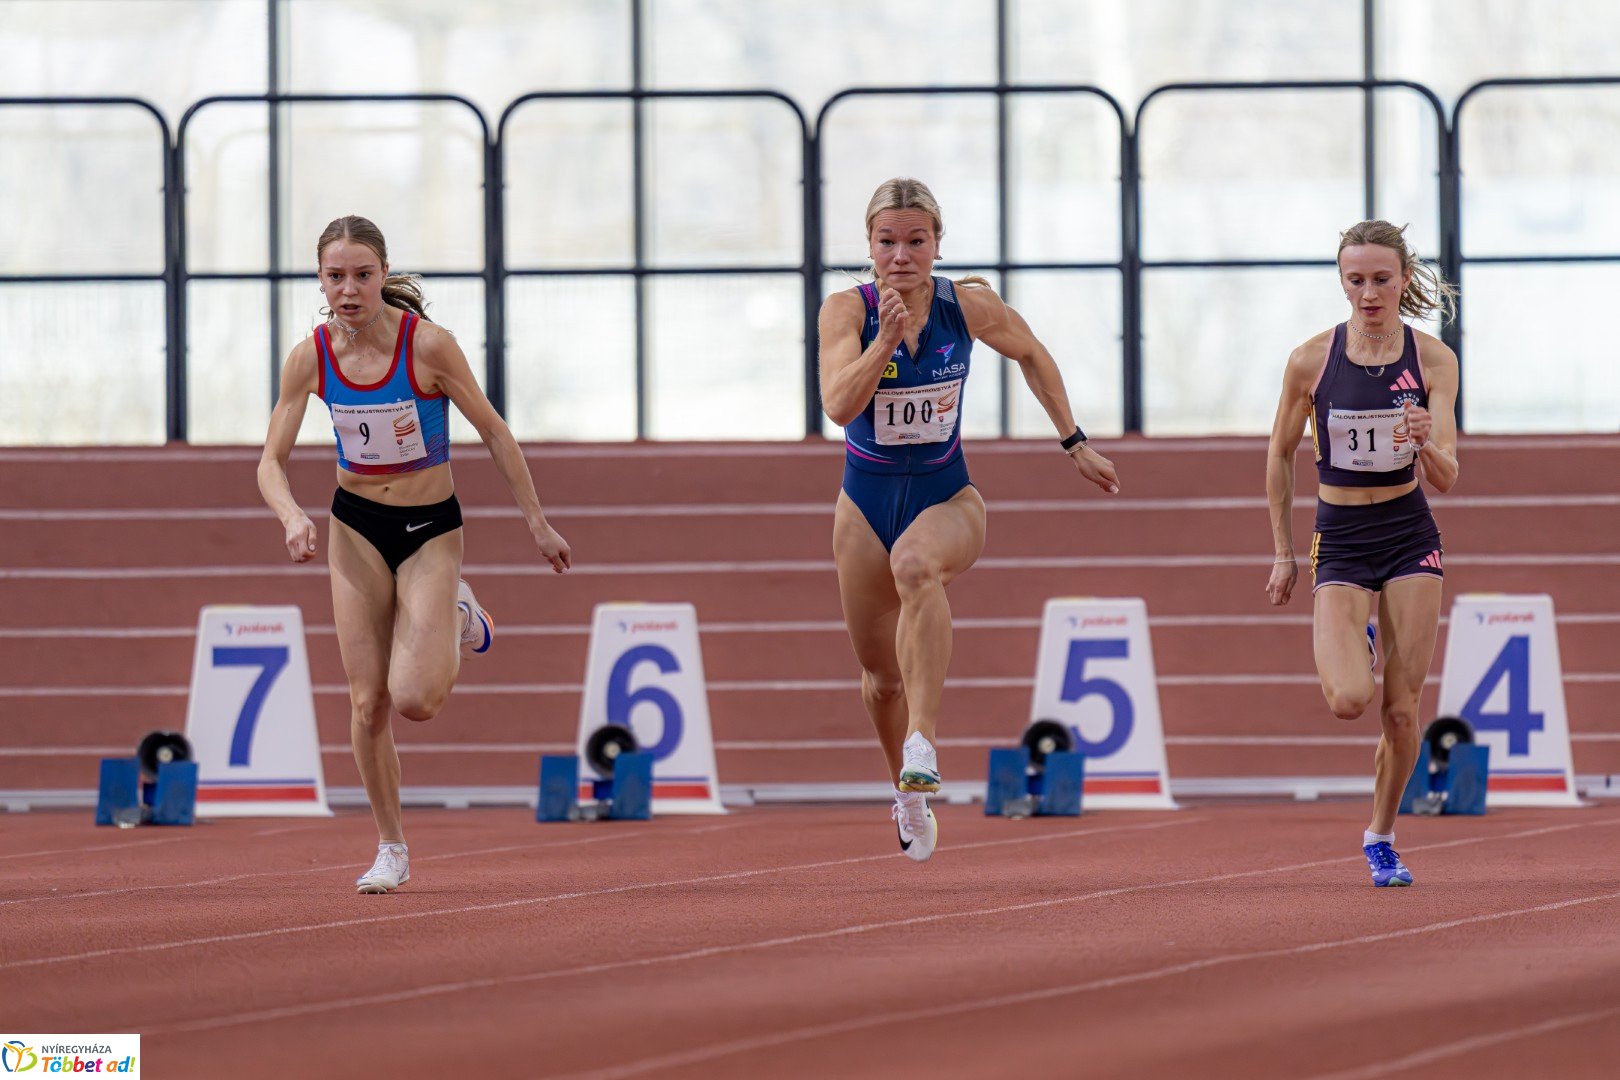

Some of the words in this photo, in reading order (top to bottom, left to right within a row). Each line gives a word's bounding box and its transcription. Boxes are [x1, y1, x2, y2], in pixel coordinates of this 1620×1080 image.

[932, 362, 966, 378] NASA
[359, 422, 370, 446] 9
[886, 400, 933, 426] 100
[1348, 428, 1376, 452] 31
[211, 646, 290, 767] 7
[606, 643, 685, 763] 6
[1060, 638, 1136, 759] 5
[1460, 634, 1545, 756] 4
